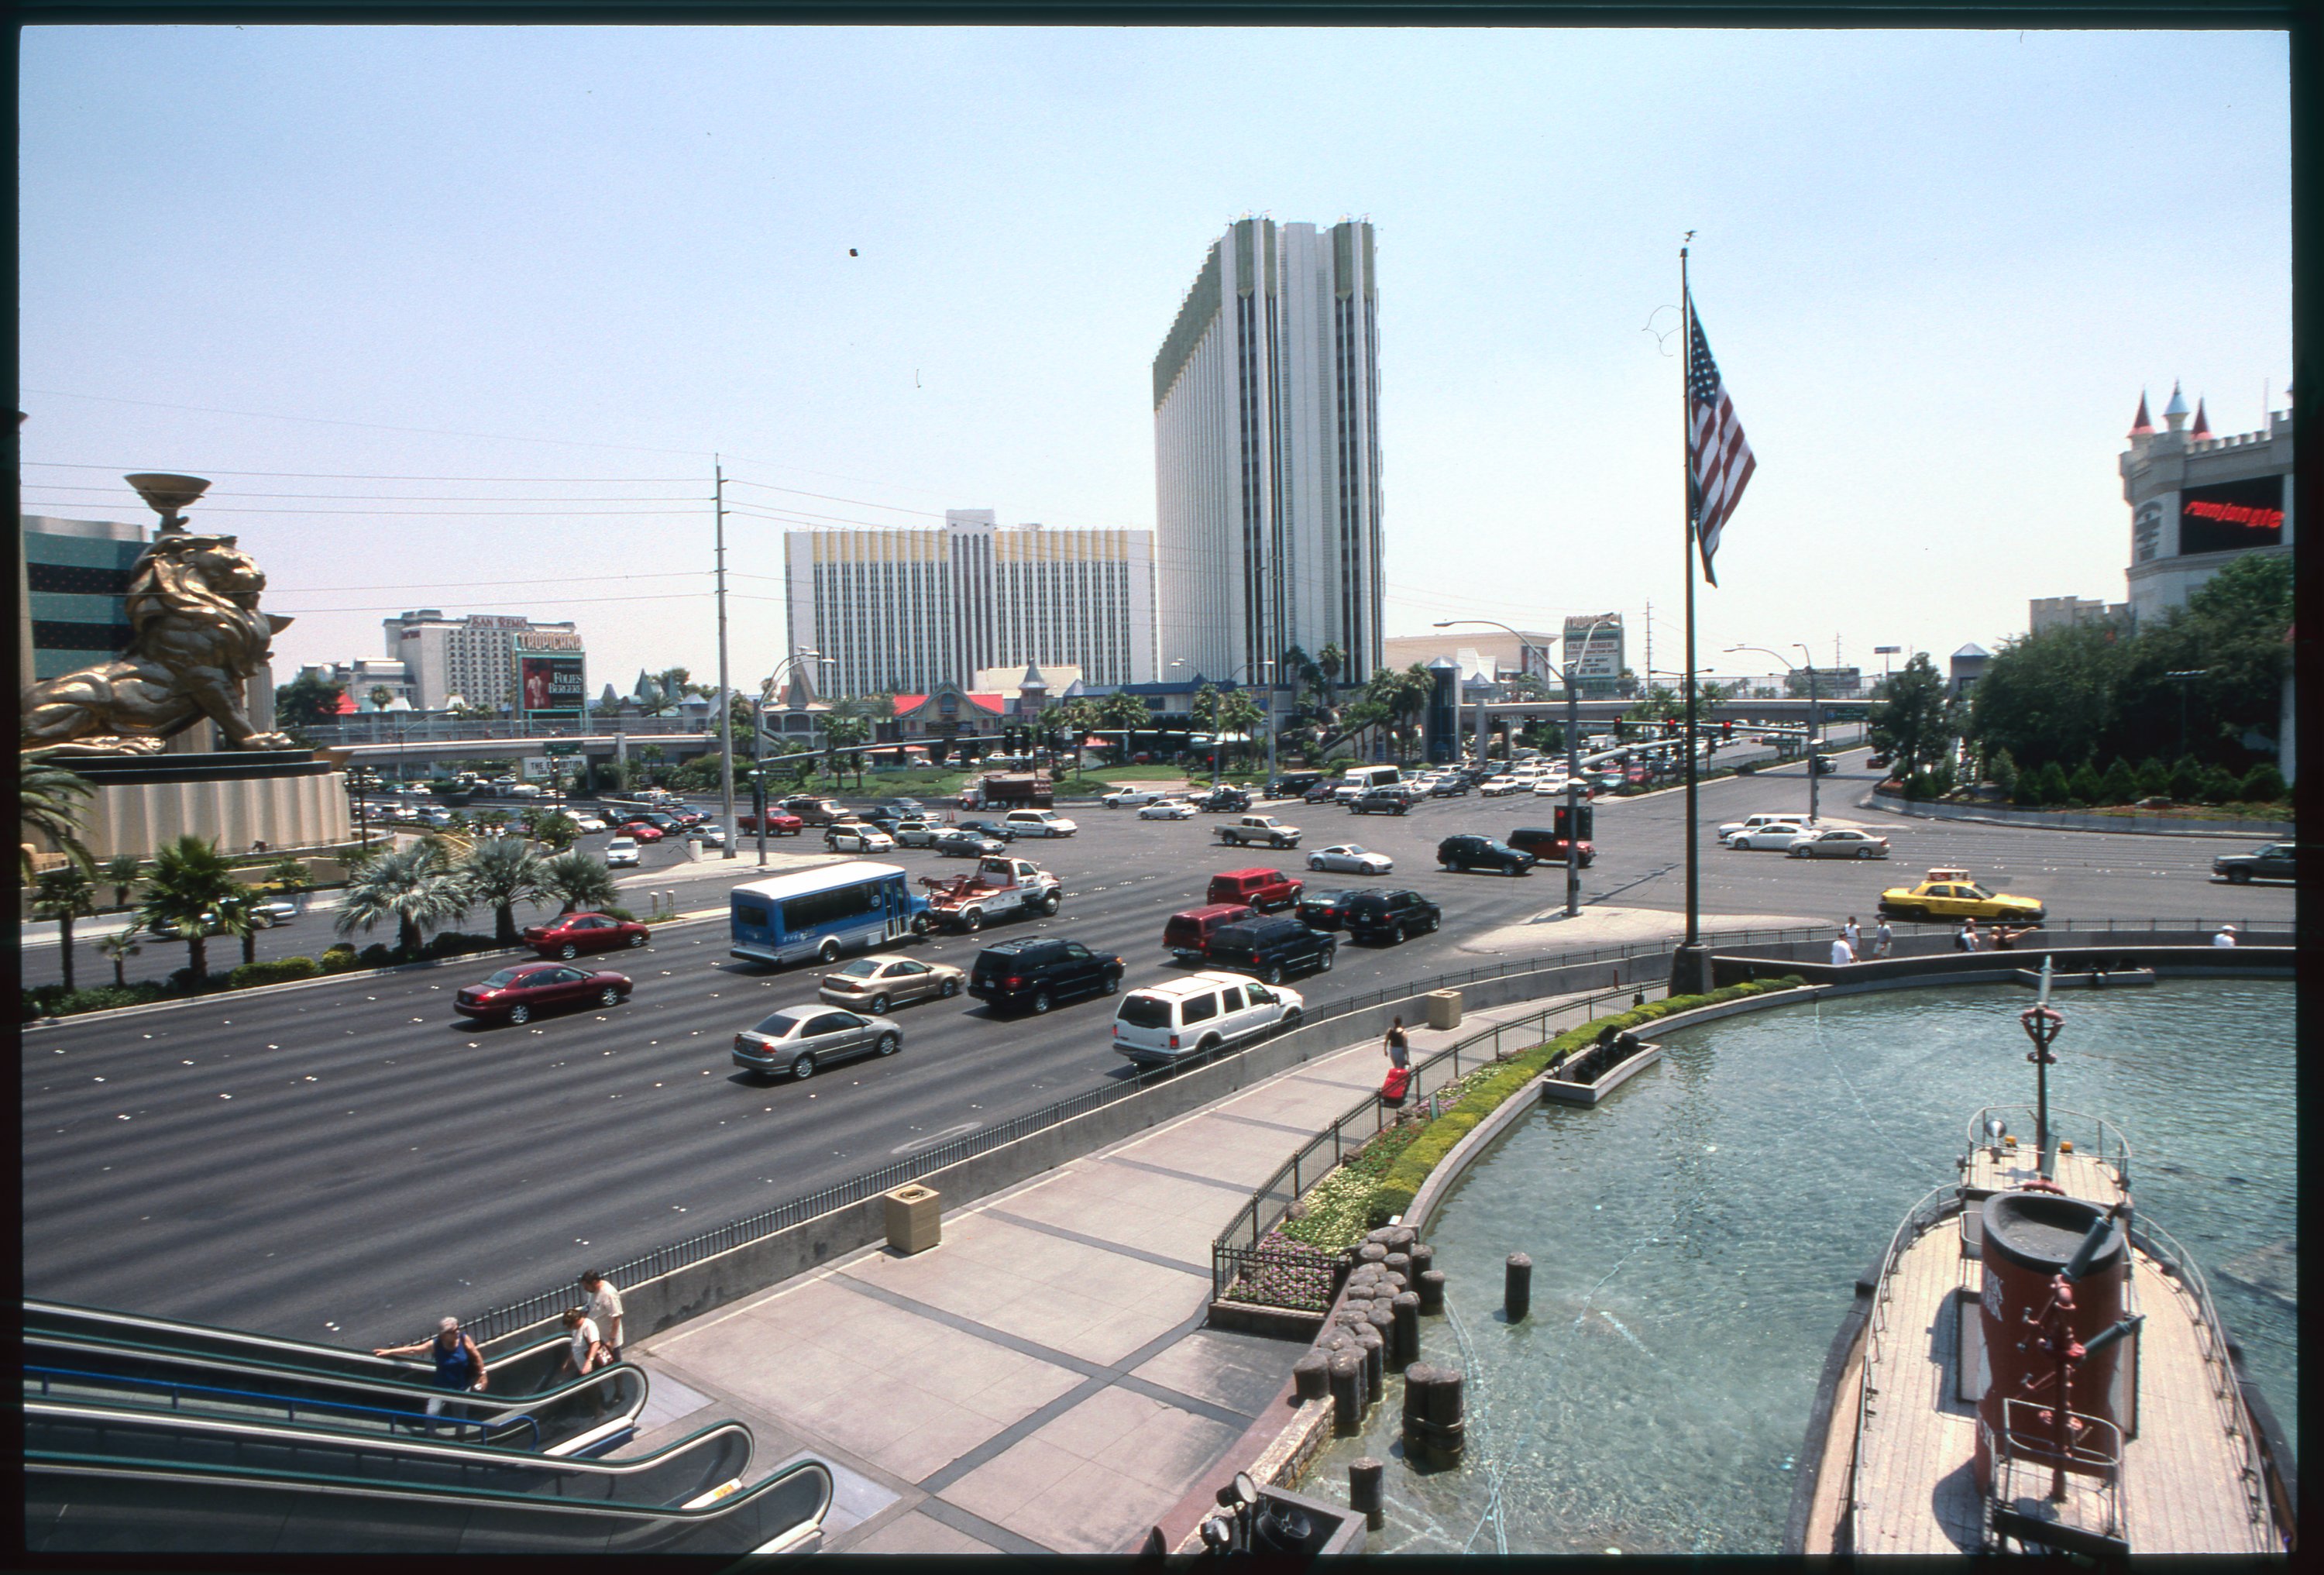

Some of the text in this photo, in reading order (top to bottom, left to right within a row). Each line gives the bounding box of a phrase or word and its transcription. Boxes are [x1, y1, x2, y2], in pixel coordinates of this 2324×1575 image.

[471, 616, 527, 628] SAN REMO
[518, 633, 582, 650] TROPICANA
[553, 672, 583, 684] FOLIES
[548, 683, 583, 693] BERGERE
